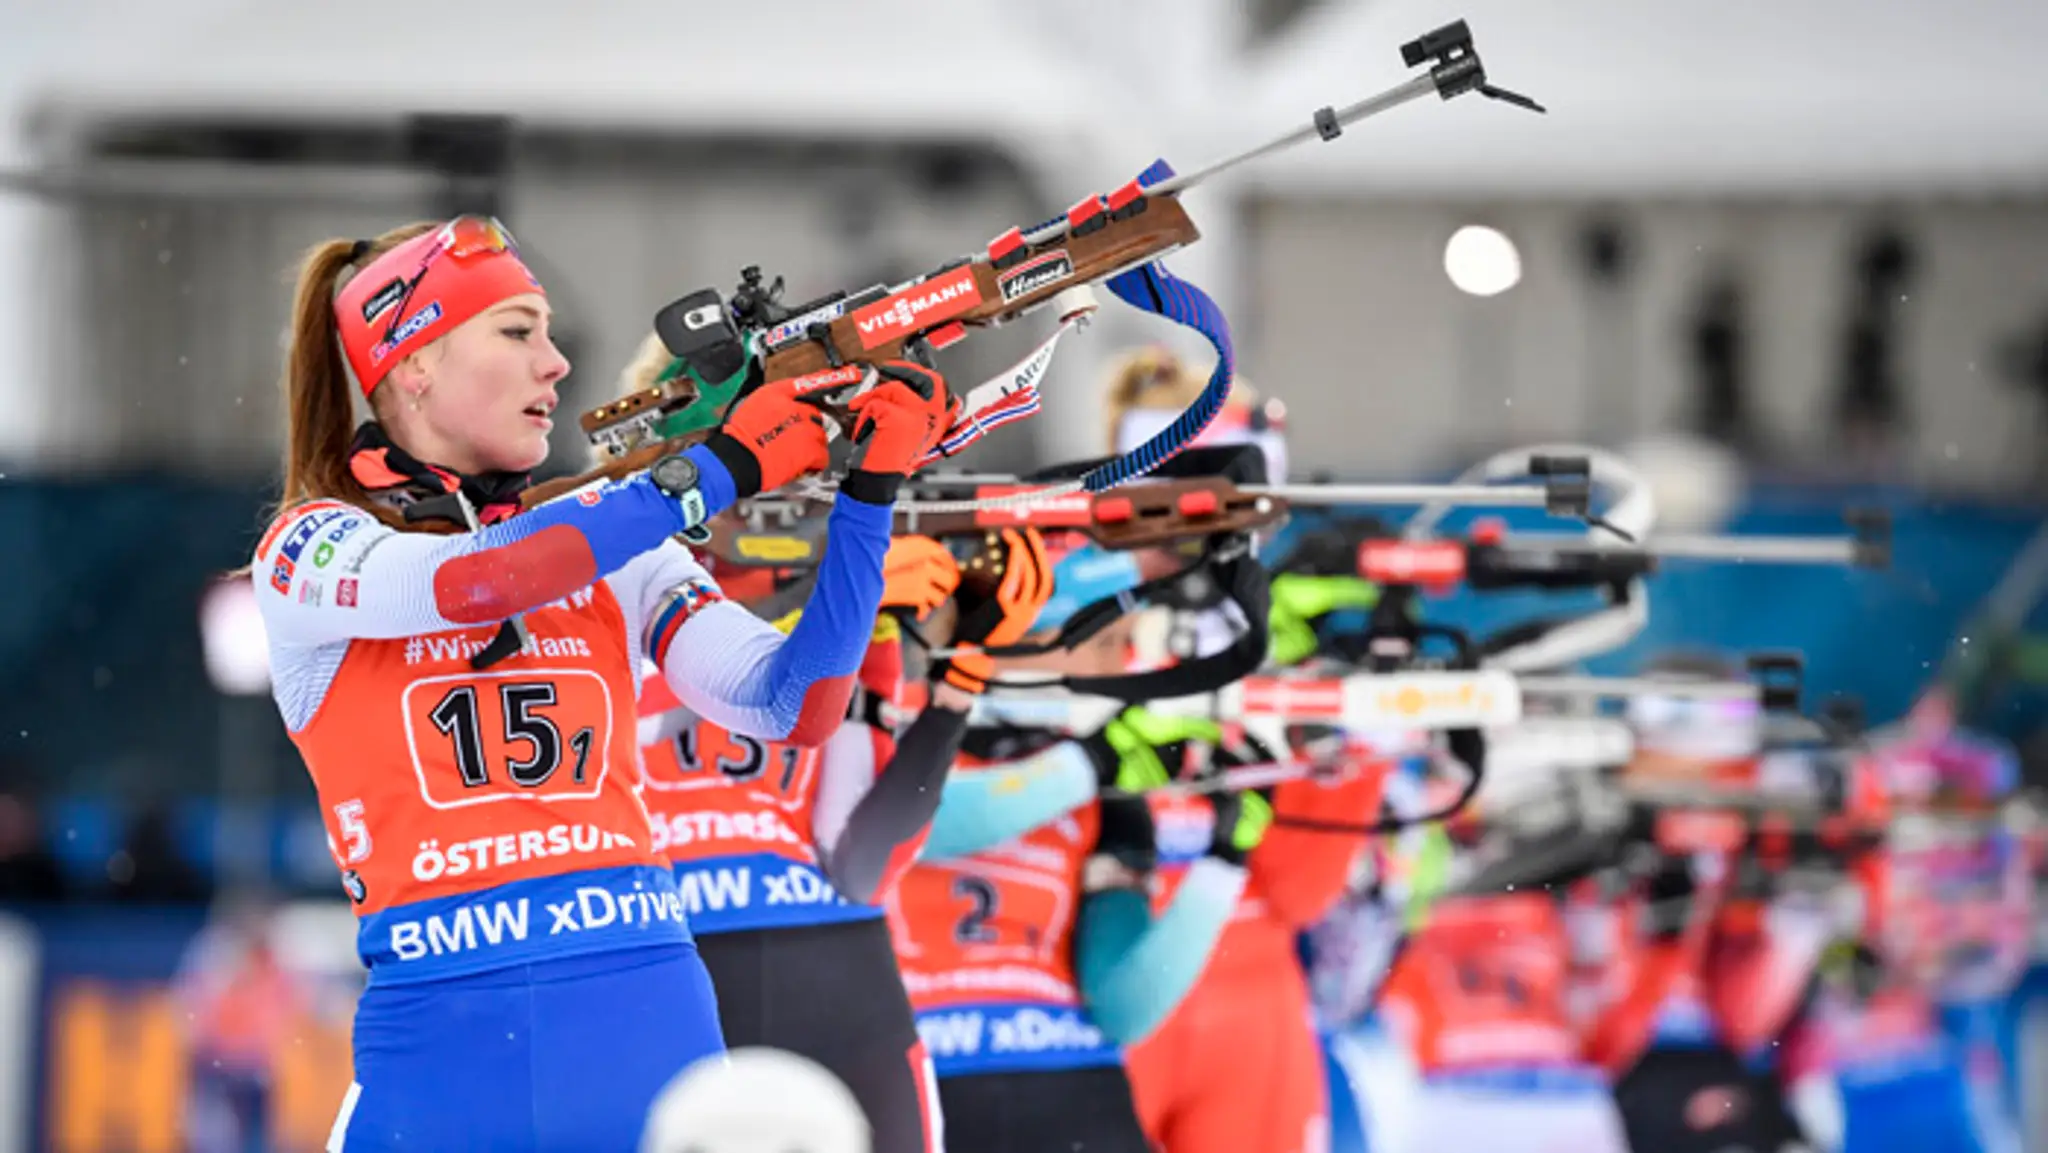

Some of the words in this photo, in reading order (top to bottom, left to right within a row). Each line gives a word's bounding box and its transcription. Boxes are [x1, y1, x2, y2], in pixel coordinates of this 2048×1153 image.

[859, 278, 974, 332] VIESSMANN
[428, 682, 563, 787] 15
[569, 727, 594, 784] 1
[412, 824, 636, 882] ÖSTERSUN
[390, 898, 530, 961] BMW
[545, 881, 684, 935] xDrive
[679, 866, 750, 915] MW
[953, 876, 999, 945] 2
